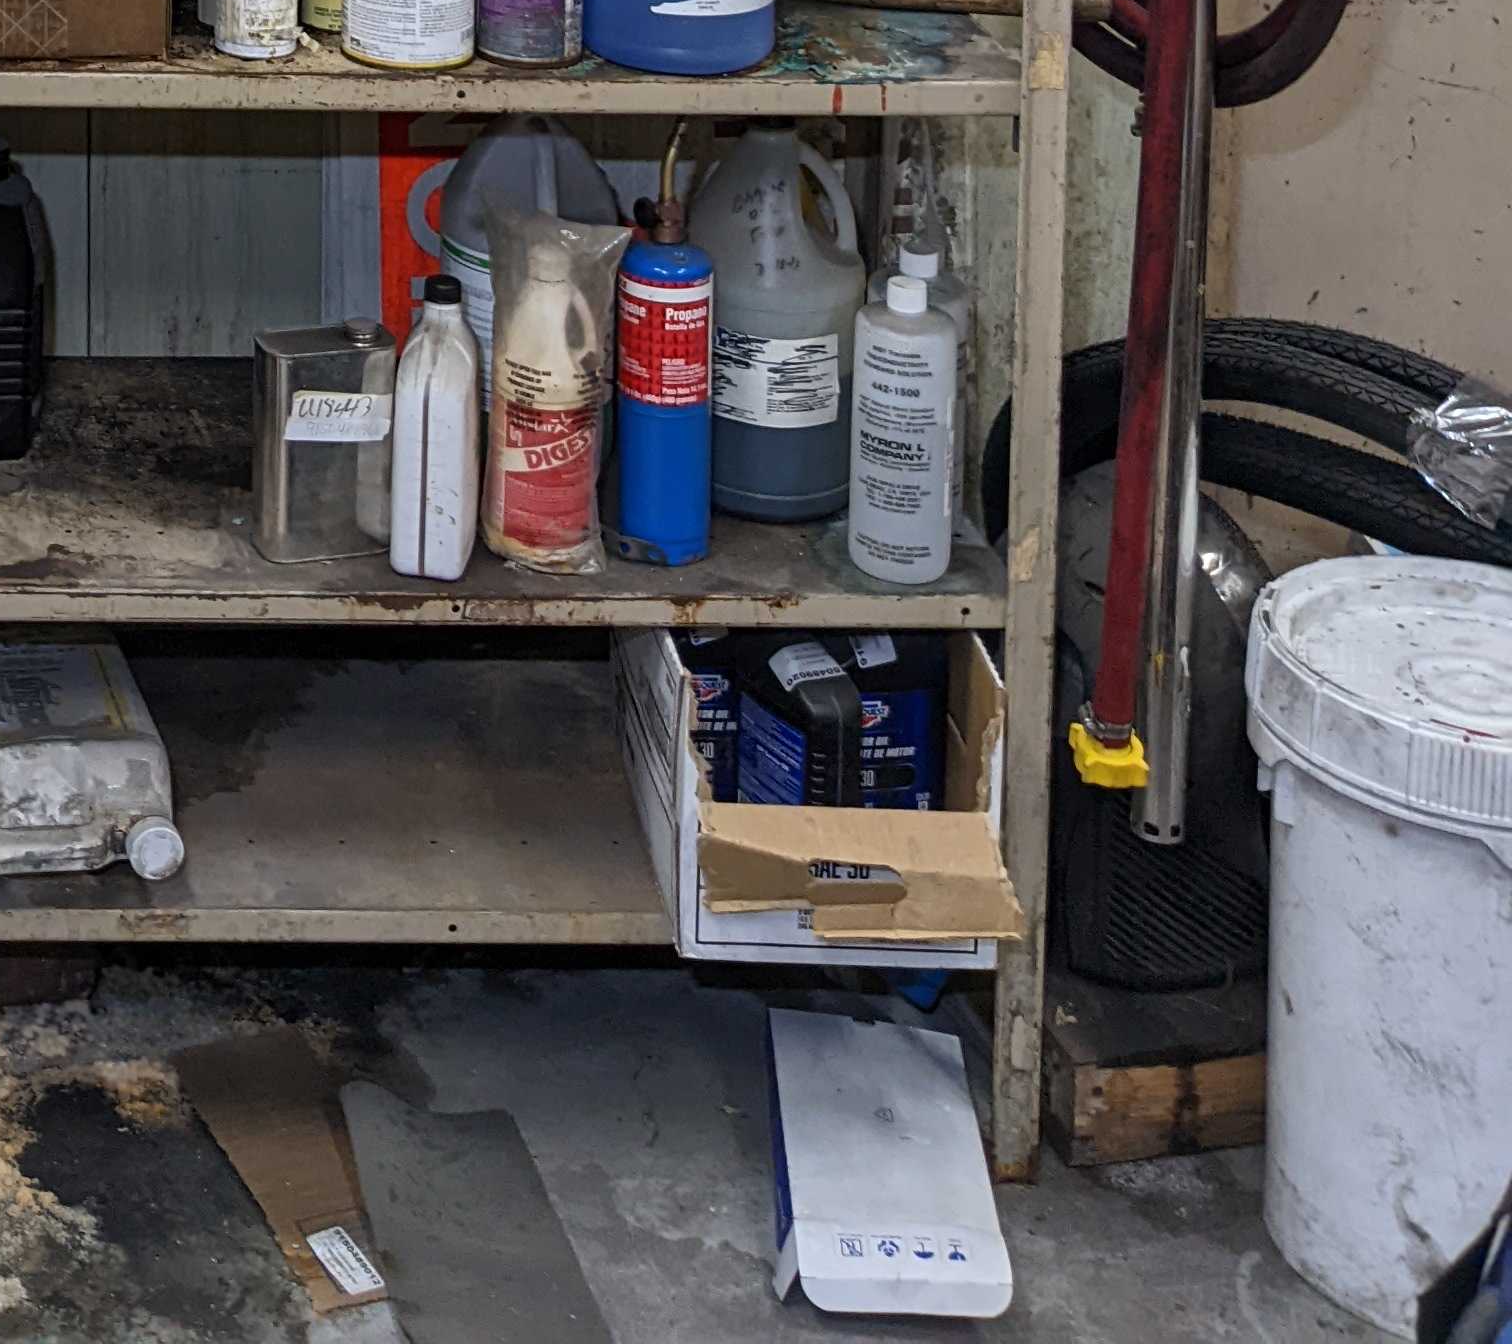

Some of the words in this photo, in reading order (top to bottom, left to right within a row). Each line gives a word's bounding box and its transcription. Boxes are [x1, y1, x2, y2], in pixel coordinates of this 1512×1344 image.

[871, 381, 921, 398] 442-1500
[860, 429, 912, 452] MYRON
[916, 442, 925, 452] L
[860, 440, 924, 461] COMPANY
[860, 769, 875, 787] 30
